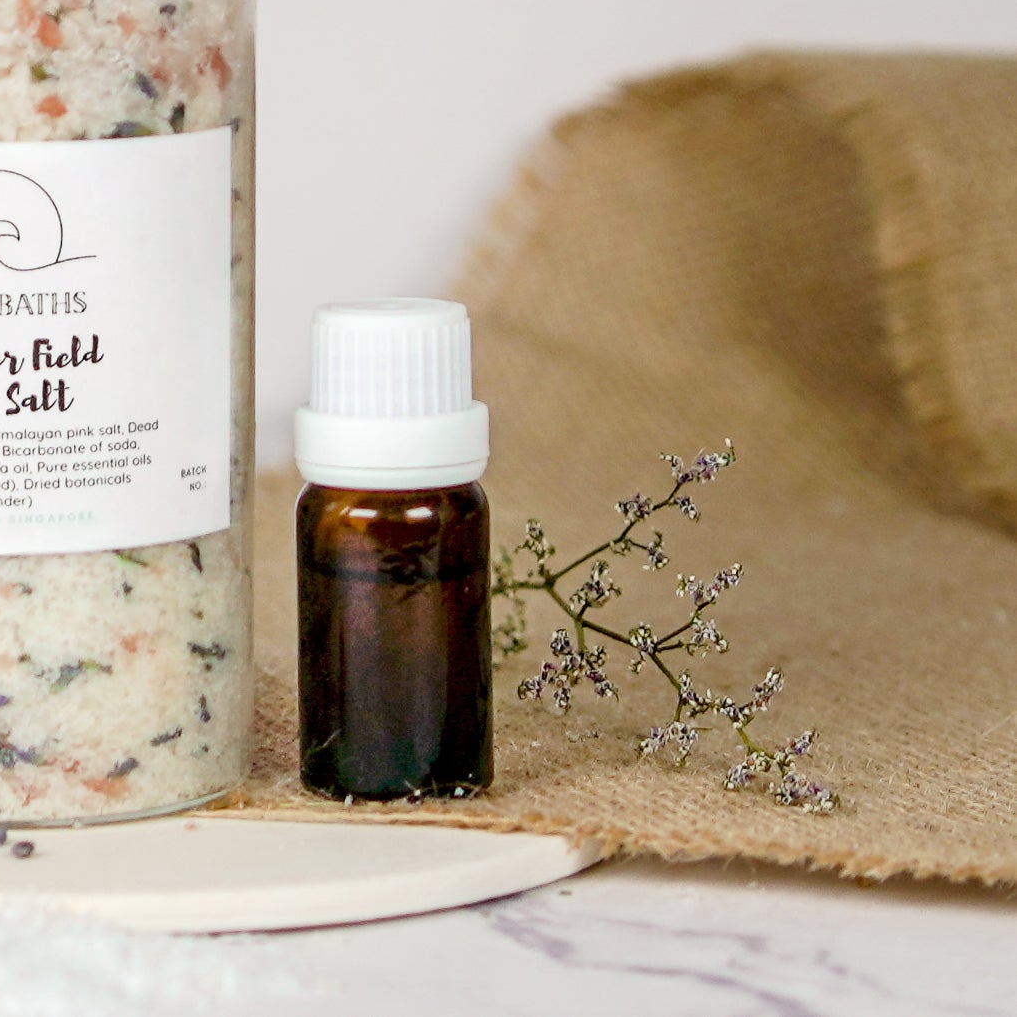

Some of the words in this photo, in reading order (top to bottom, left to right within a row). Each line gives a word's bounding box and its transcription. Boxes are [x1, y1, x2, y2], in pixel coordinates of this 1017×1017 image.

[33, 333, 104, 371] Field
[5, 379, 75, 415] Salt
[67, 426, 94, 440] pink
[99, 425, 124, 435] salt,
[128, 420, 159, 433] Dead
[2, 444, 86, 456] Bicarbonate
[90, 441, 102, 453] of
[107, 439, 140, 451] soda,
[13, 462, 32, 474] oil,
[38, 462, 67, 472] Pure
[72, 457, 128, 471] essential
[132, 454, 152, 466] oils
[181, 465, 207, 478] BATCH
[24, 476, 60, 490] Dried
[65, 473, 132, 488] botanicals
[8, 511, 96, 524] SINGAPORE
